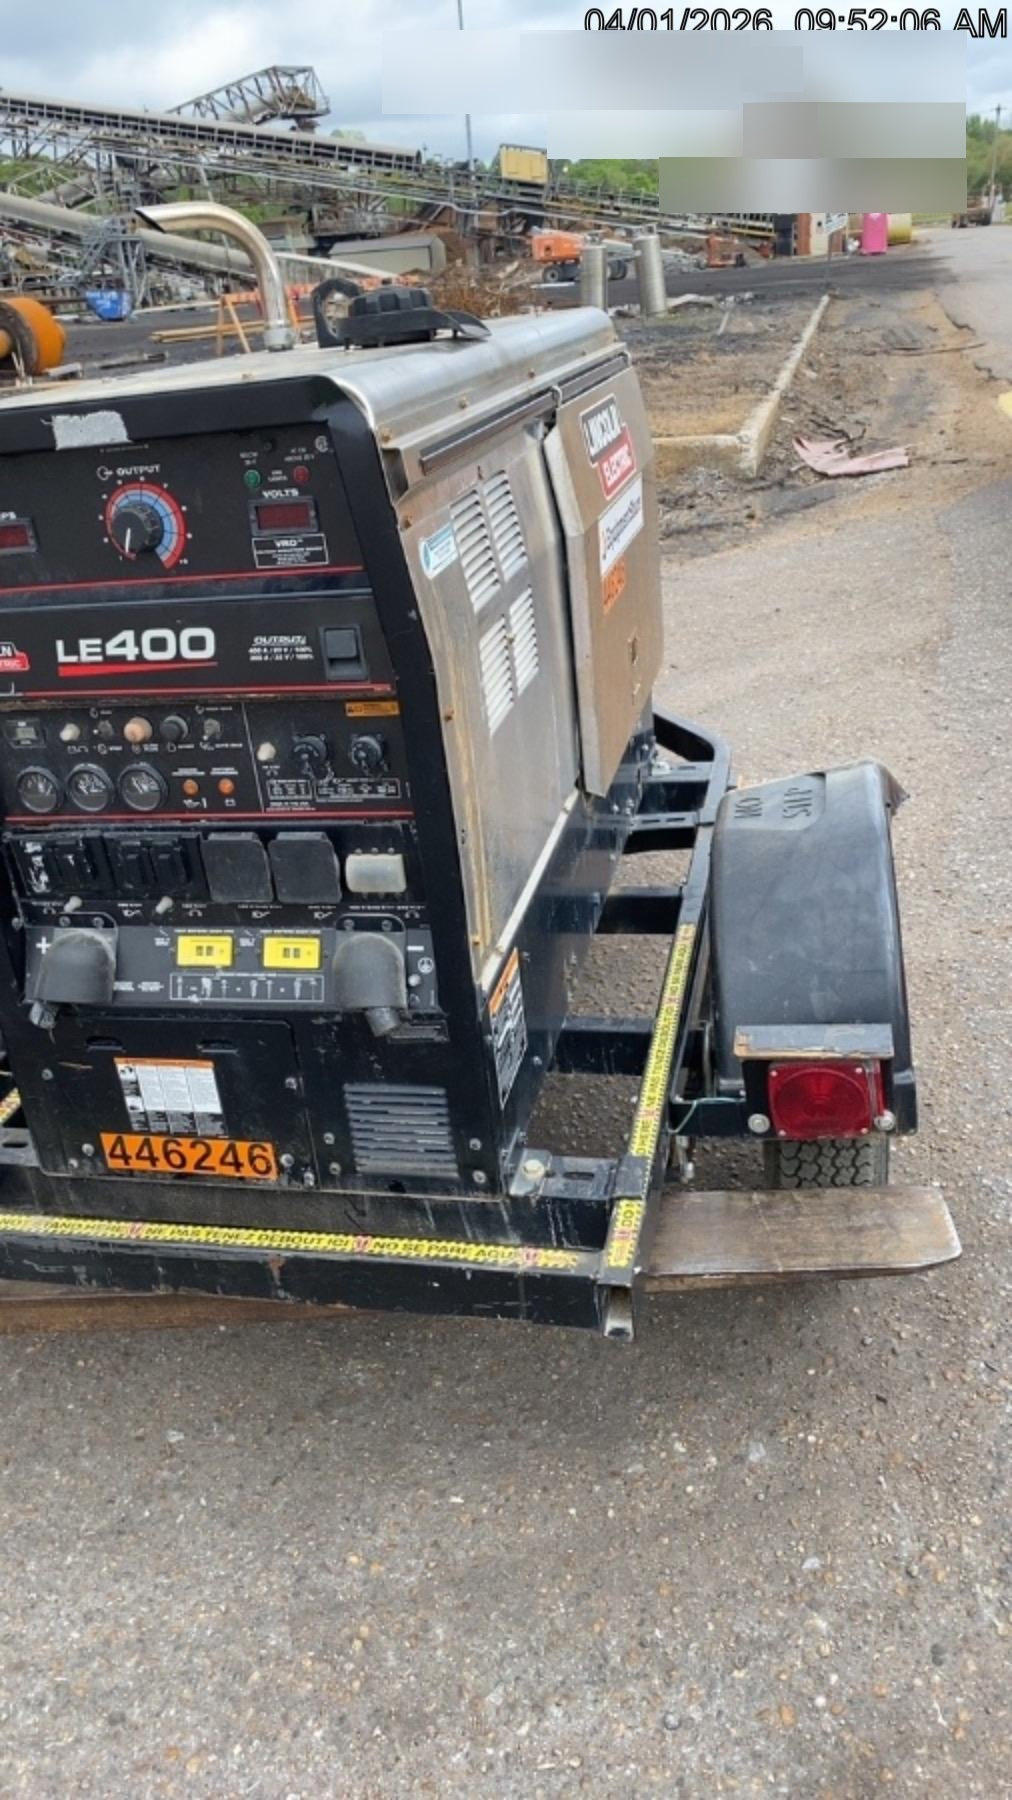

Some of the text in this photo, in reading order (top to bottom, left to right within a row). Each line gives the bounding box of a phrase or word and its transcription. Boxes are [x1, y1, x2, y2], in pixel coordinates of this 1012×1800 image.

[116, 464, 161, 477] OUTPUT
[262, 488, 299, 499] VOLTS
[56, 627, 215, 663] LE400
[108, 1135, 273, 1176] 446246
